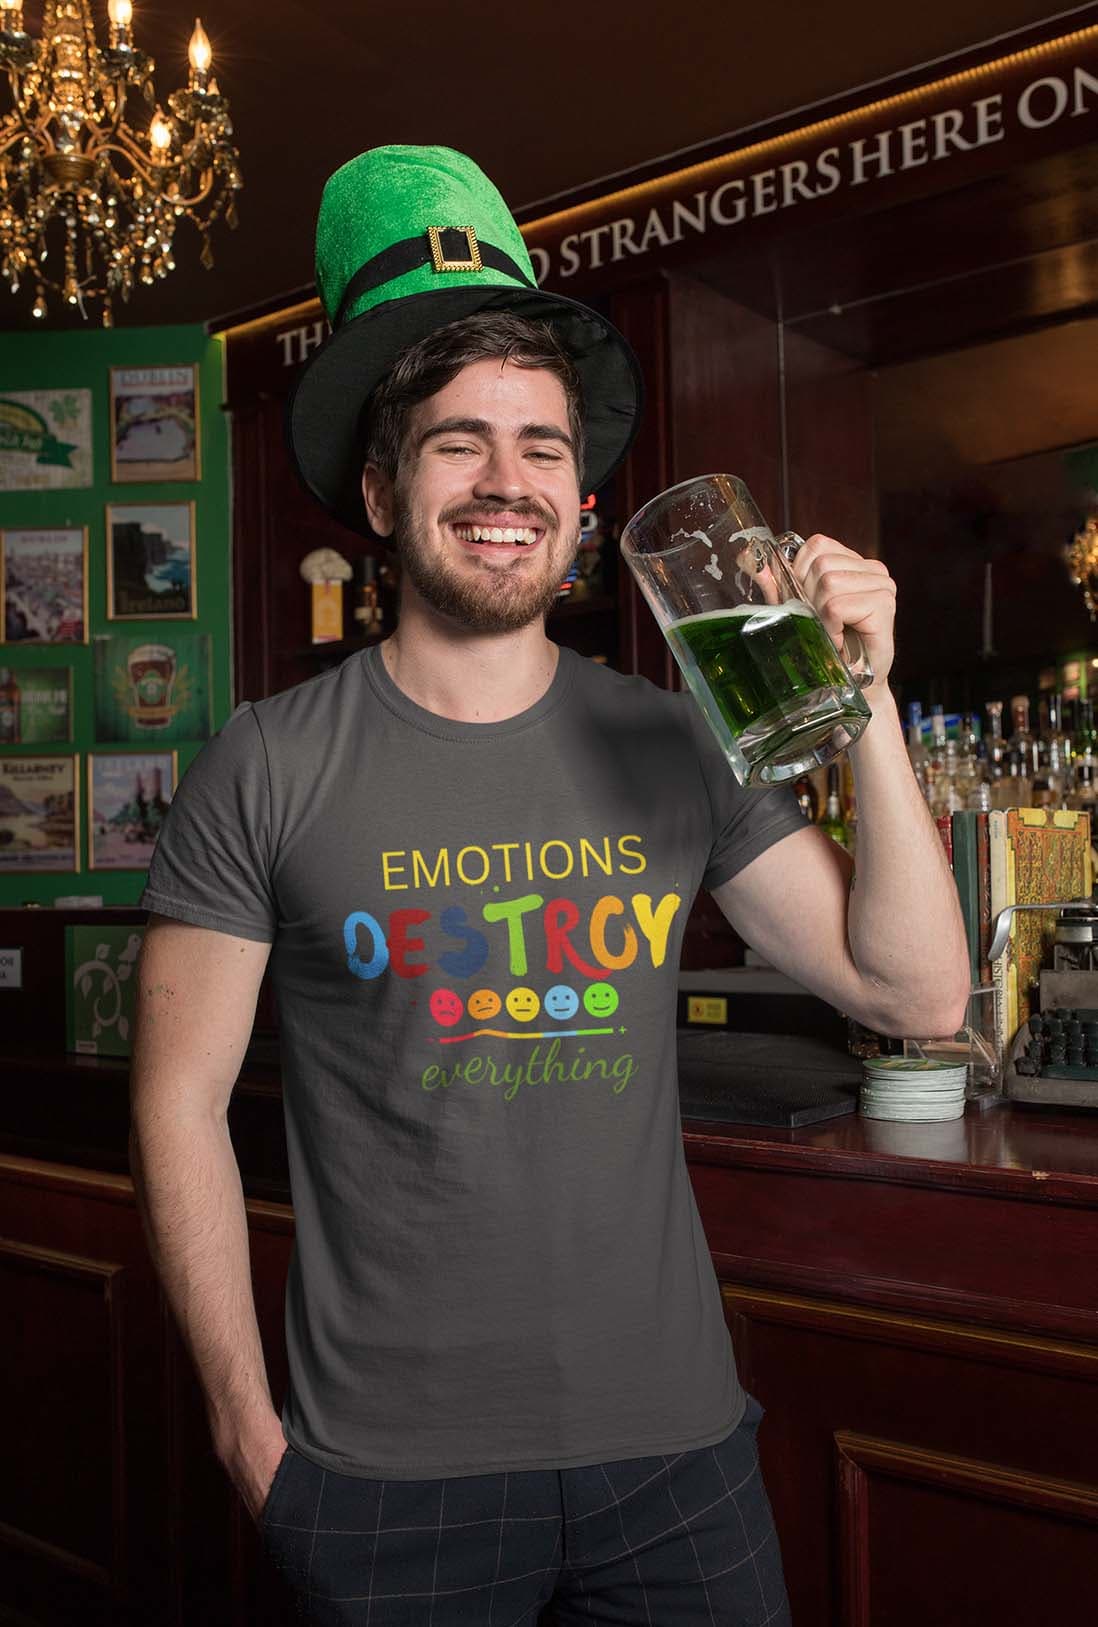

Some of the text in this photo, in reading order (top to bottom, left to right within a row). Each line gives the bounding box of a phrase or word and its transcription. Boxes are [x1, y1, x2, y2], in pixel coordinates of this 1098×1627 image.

[559, 148, 841, 277] STRANGERS
[850, 93, 1005, 185] HERE
[381, 835, 647, 891] EMOTIONS
[343, 893, 681, 980] DESTROY
[421, 1038, 639, 1100] everything
